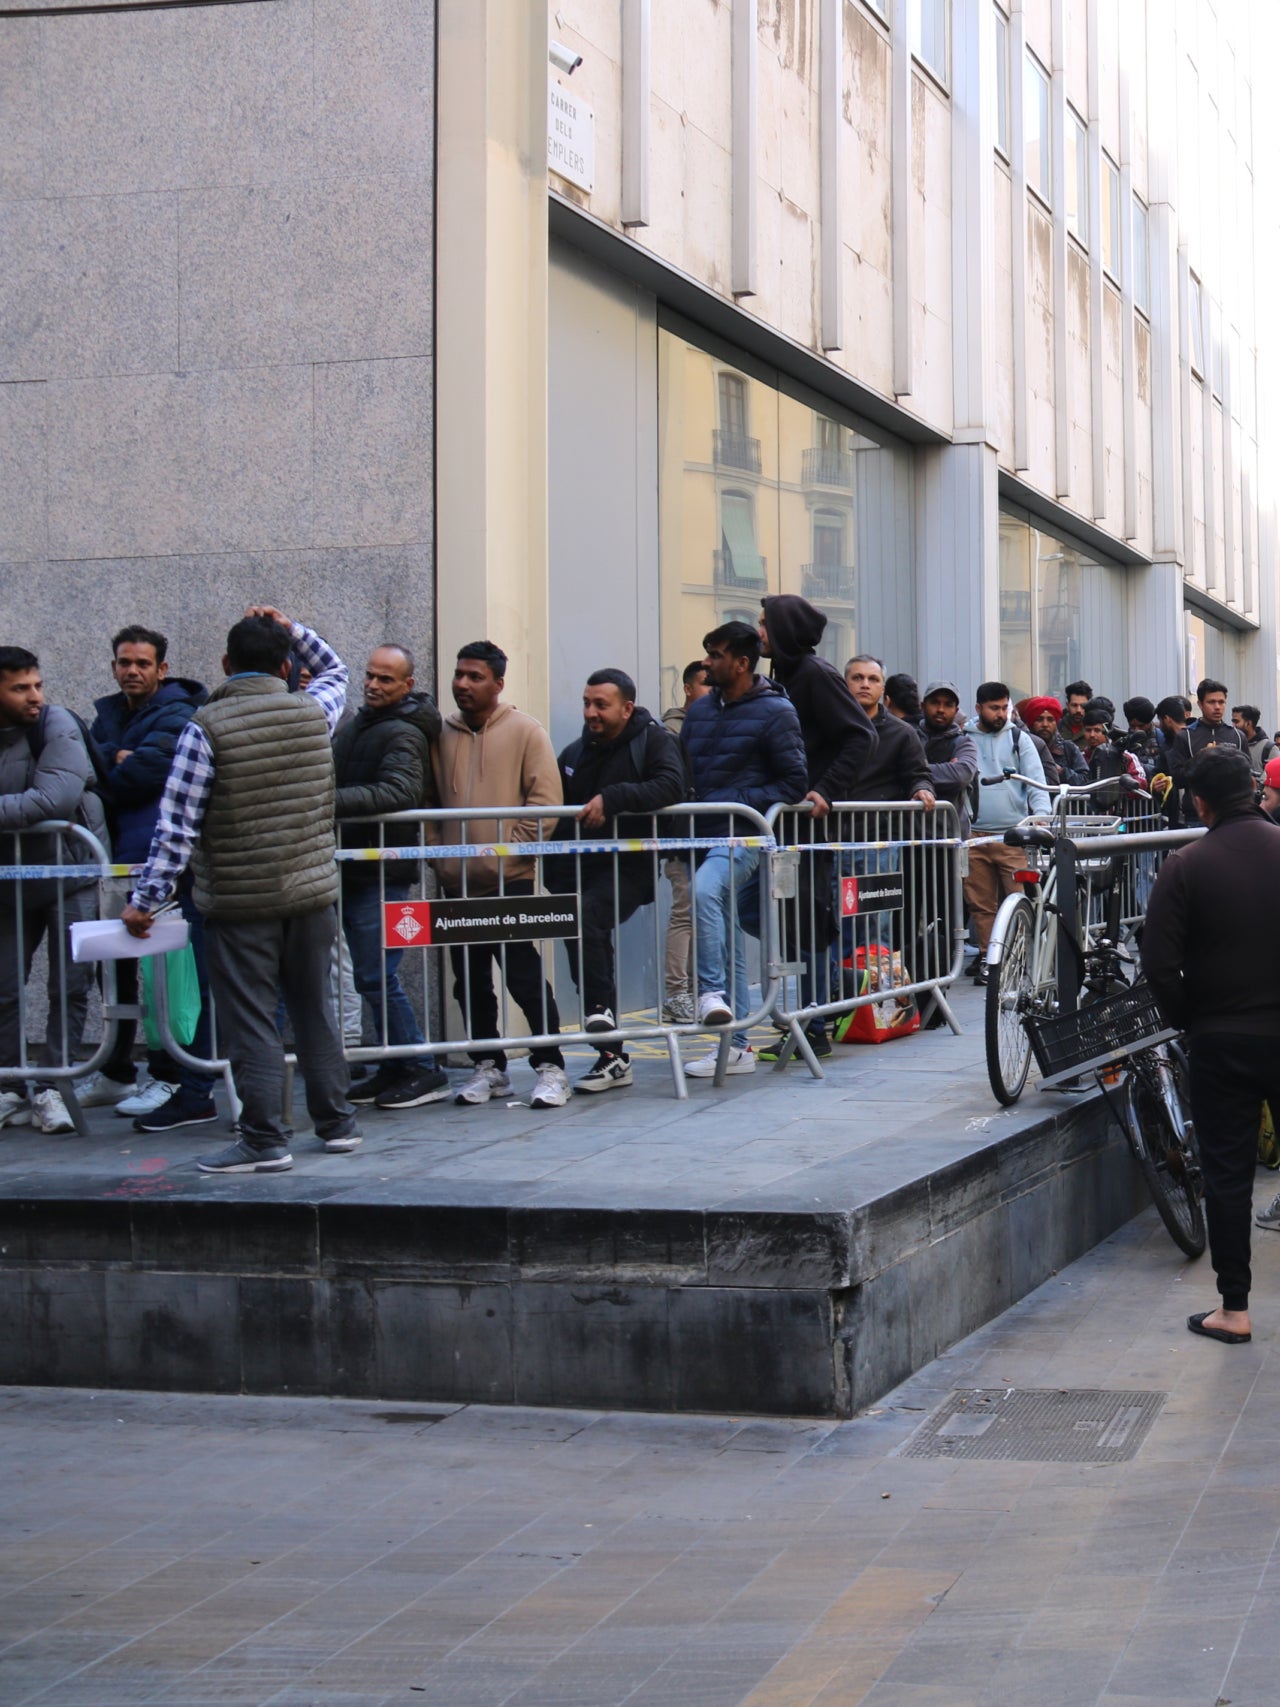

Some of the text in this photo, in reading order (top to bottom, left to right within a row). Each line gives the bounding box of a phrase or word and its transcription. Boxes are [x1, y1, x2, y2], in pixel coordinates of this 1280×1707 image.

[550, 92, 577, 120] CARRER
[547, 136, 585, 175] EMPLERS
[435, 911, 575, 931] Ajuntament de Barcelona
